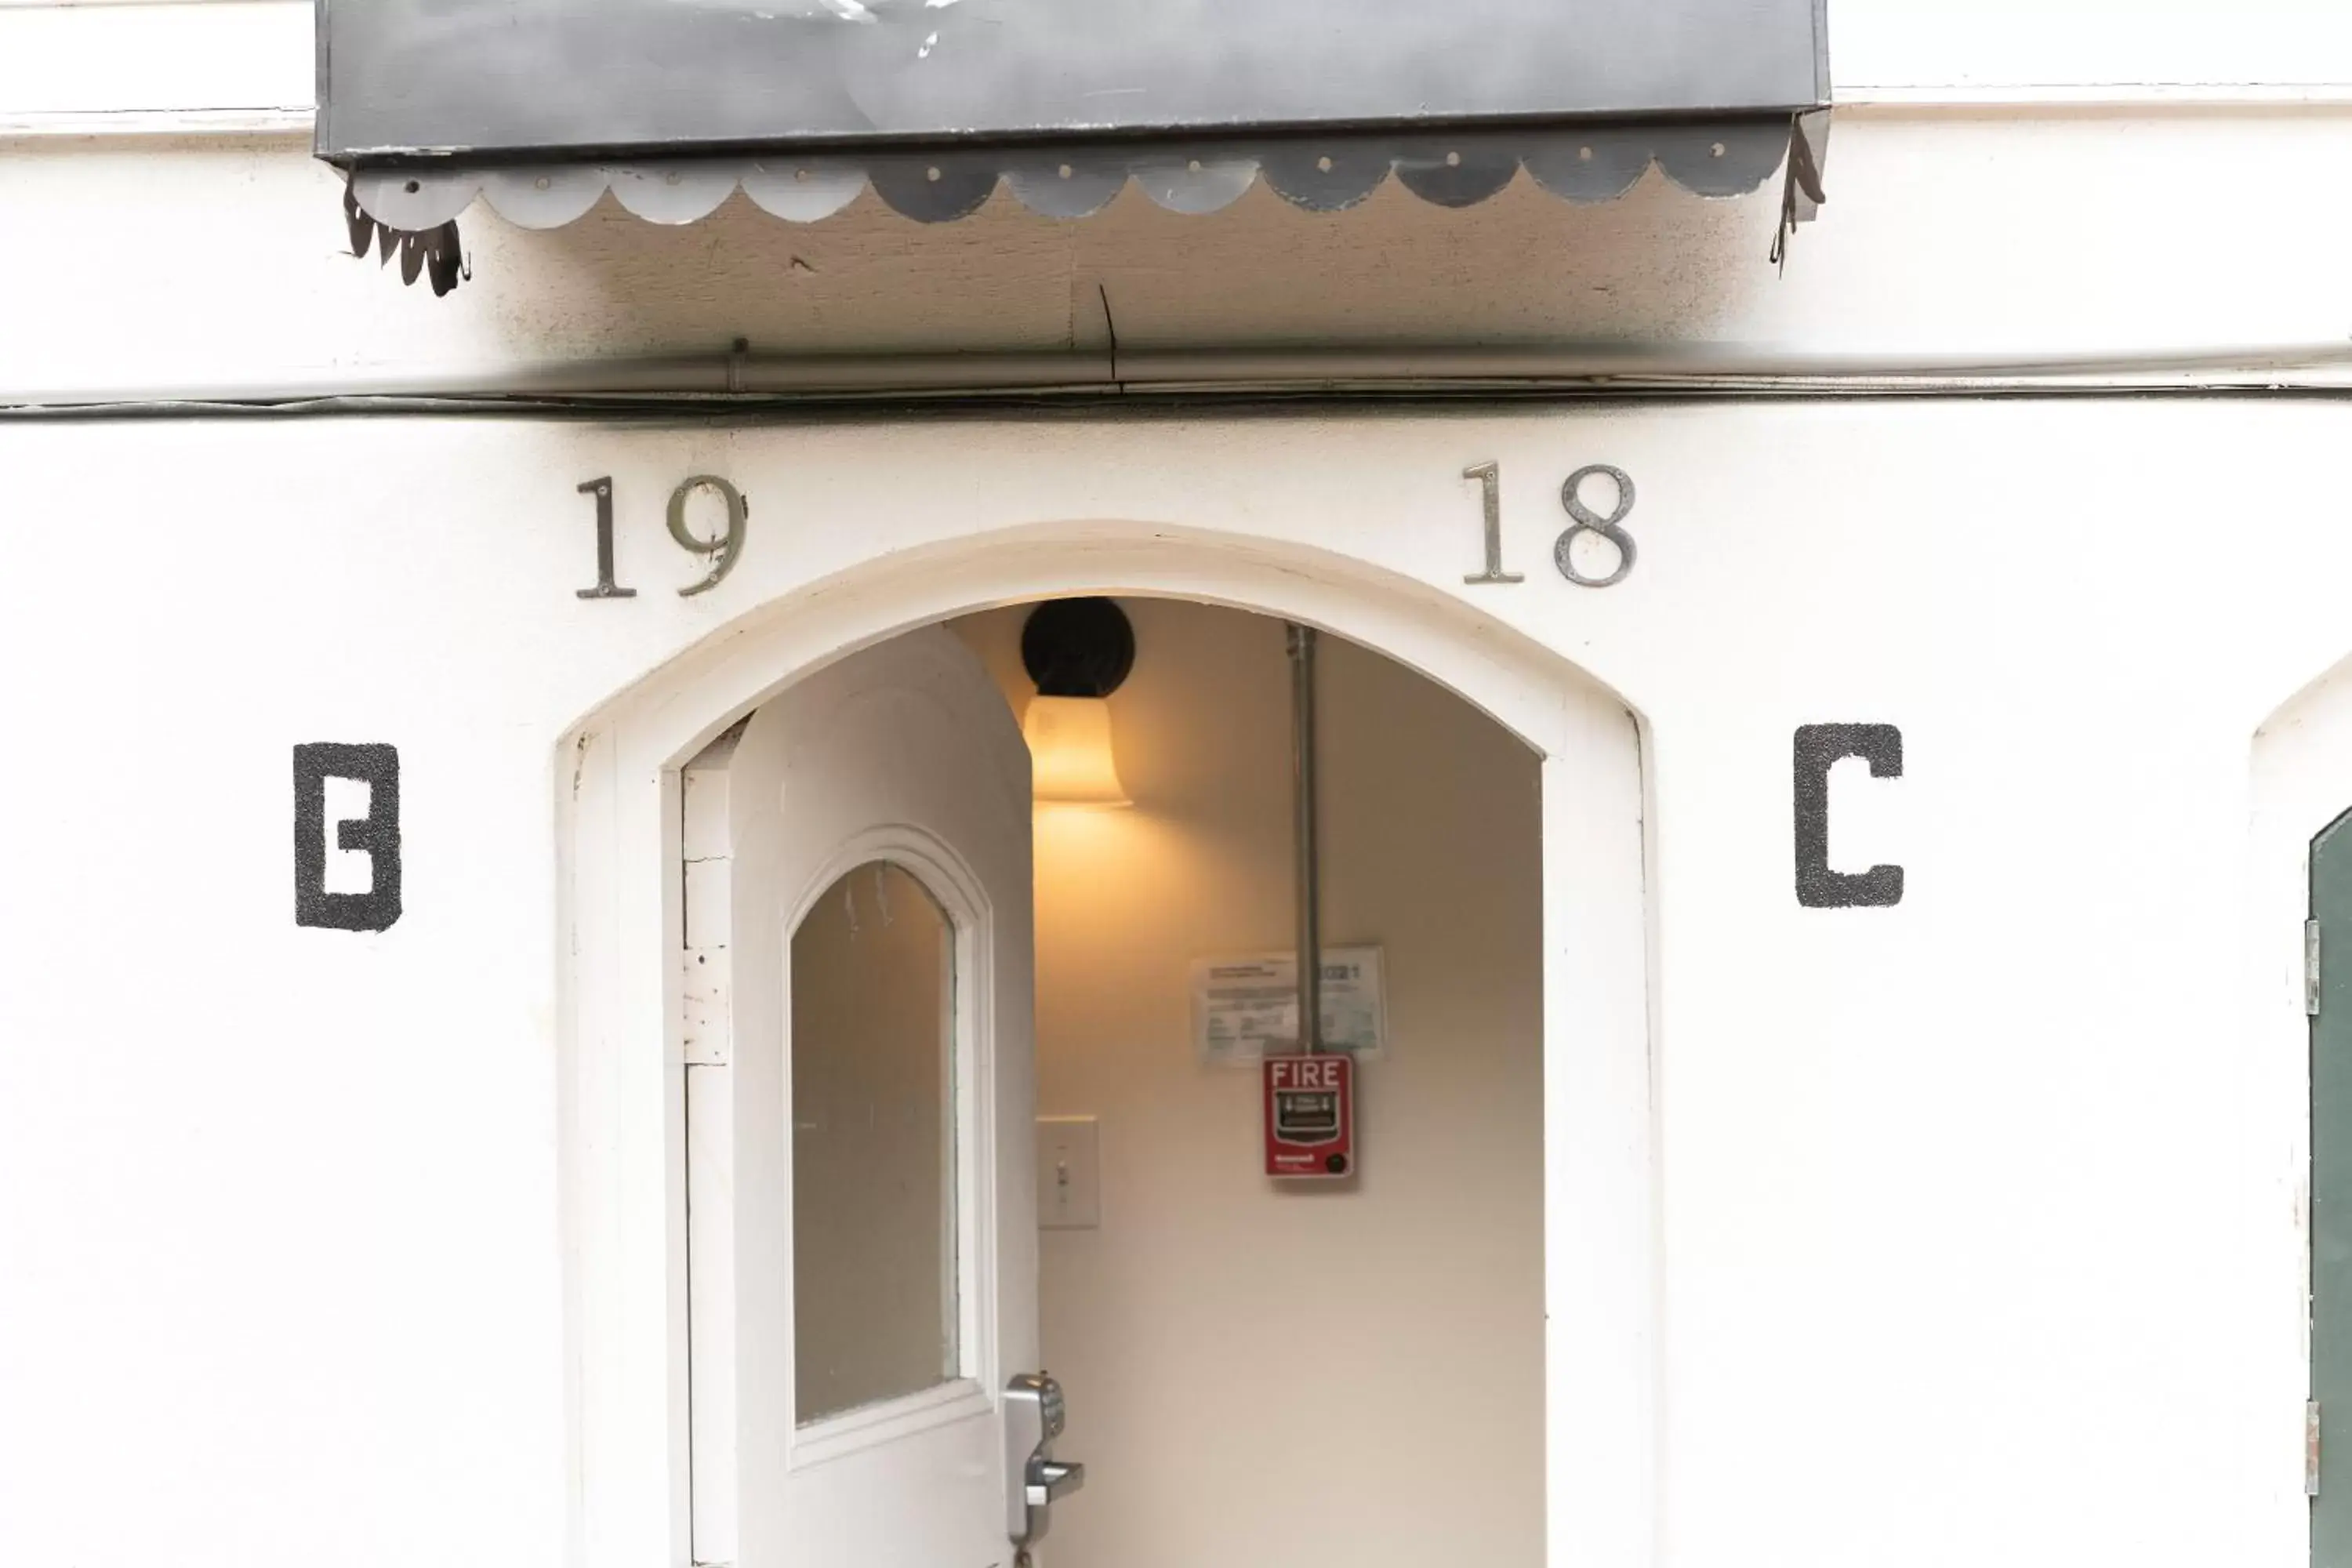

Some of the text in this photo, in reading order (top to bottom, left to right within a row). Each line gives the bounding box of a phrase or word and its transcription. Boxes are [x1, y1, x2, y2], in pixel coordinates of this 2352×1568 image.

[576, 461, 1637, 599] 19 18
[292, 742, 403, 933] B
[1793, 722, 1904, 909] C
[1272, 1061, 1340, 1087] FIRE
